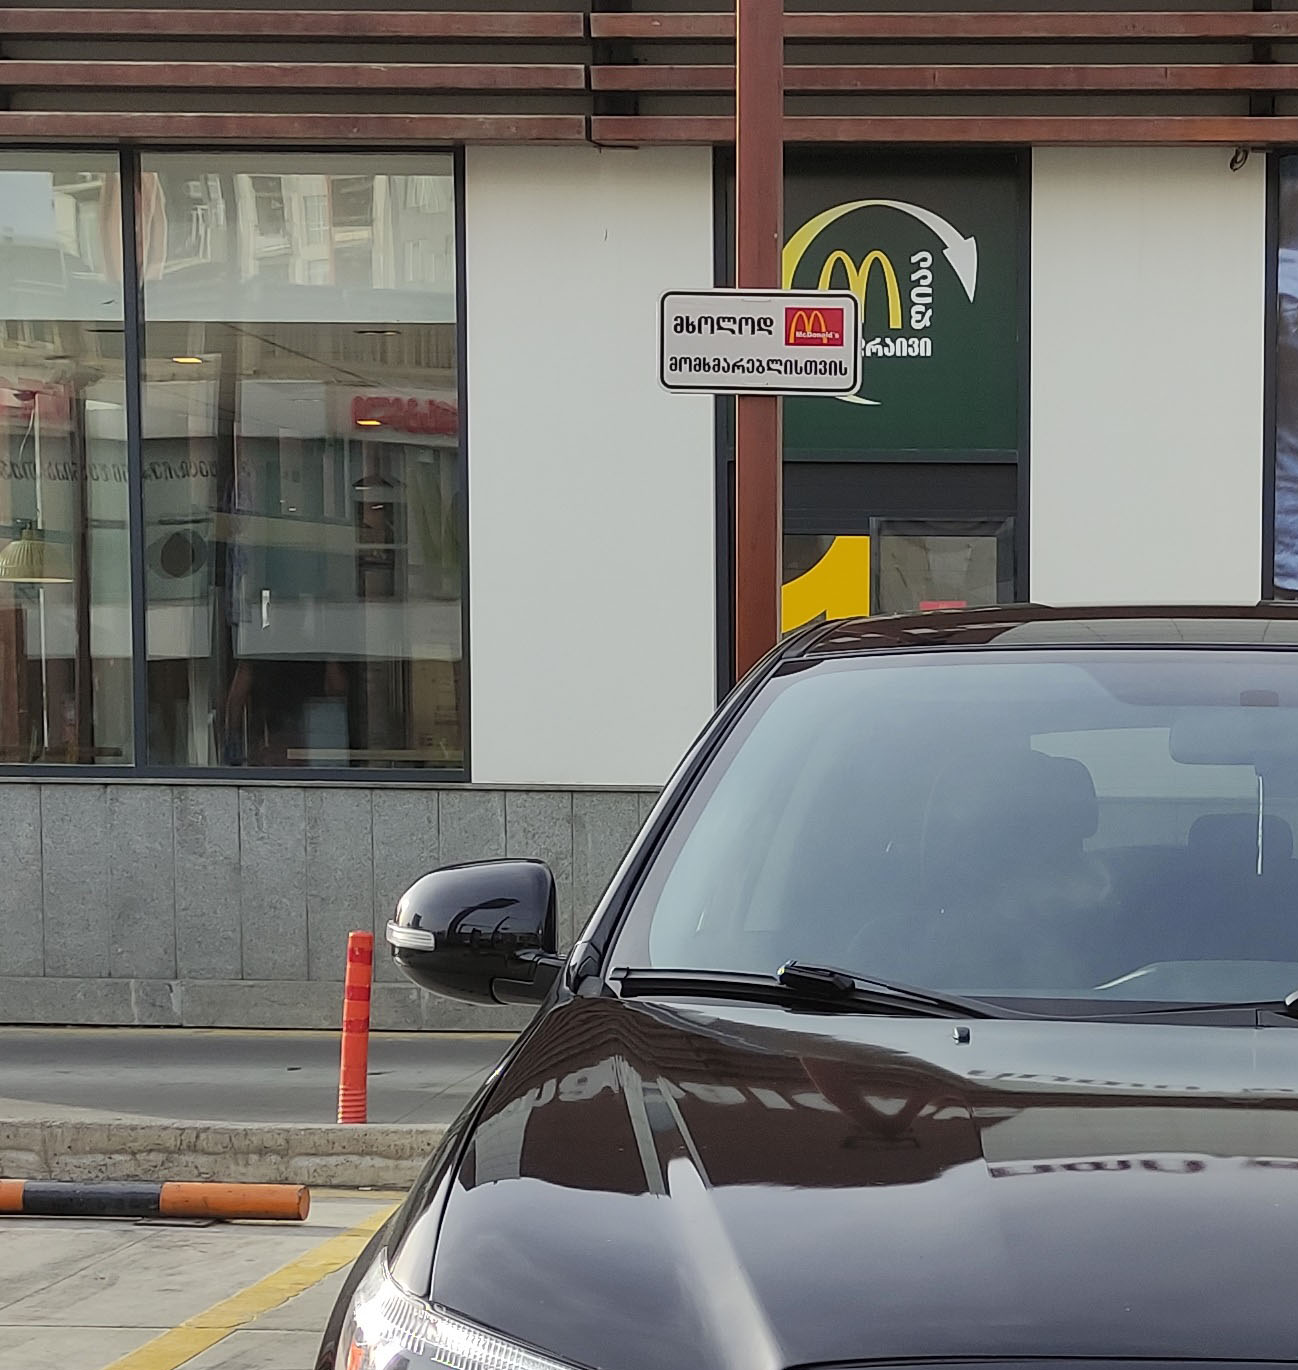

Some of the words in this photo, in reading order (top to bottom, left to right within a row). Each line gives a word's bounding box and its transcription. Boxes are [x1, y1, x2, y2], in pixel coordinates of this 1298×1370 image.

[910, 250, 933, 330] ღიაა
[672, 315, 774, 335] მხოლოდ
[861, 337, 932, 357] რაივი
[668, 356, 848, 376] მომხმარებლისთვის
